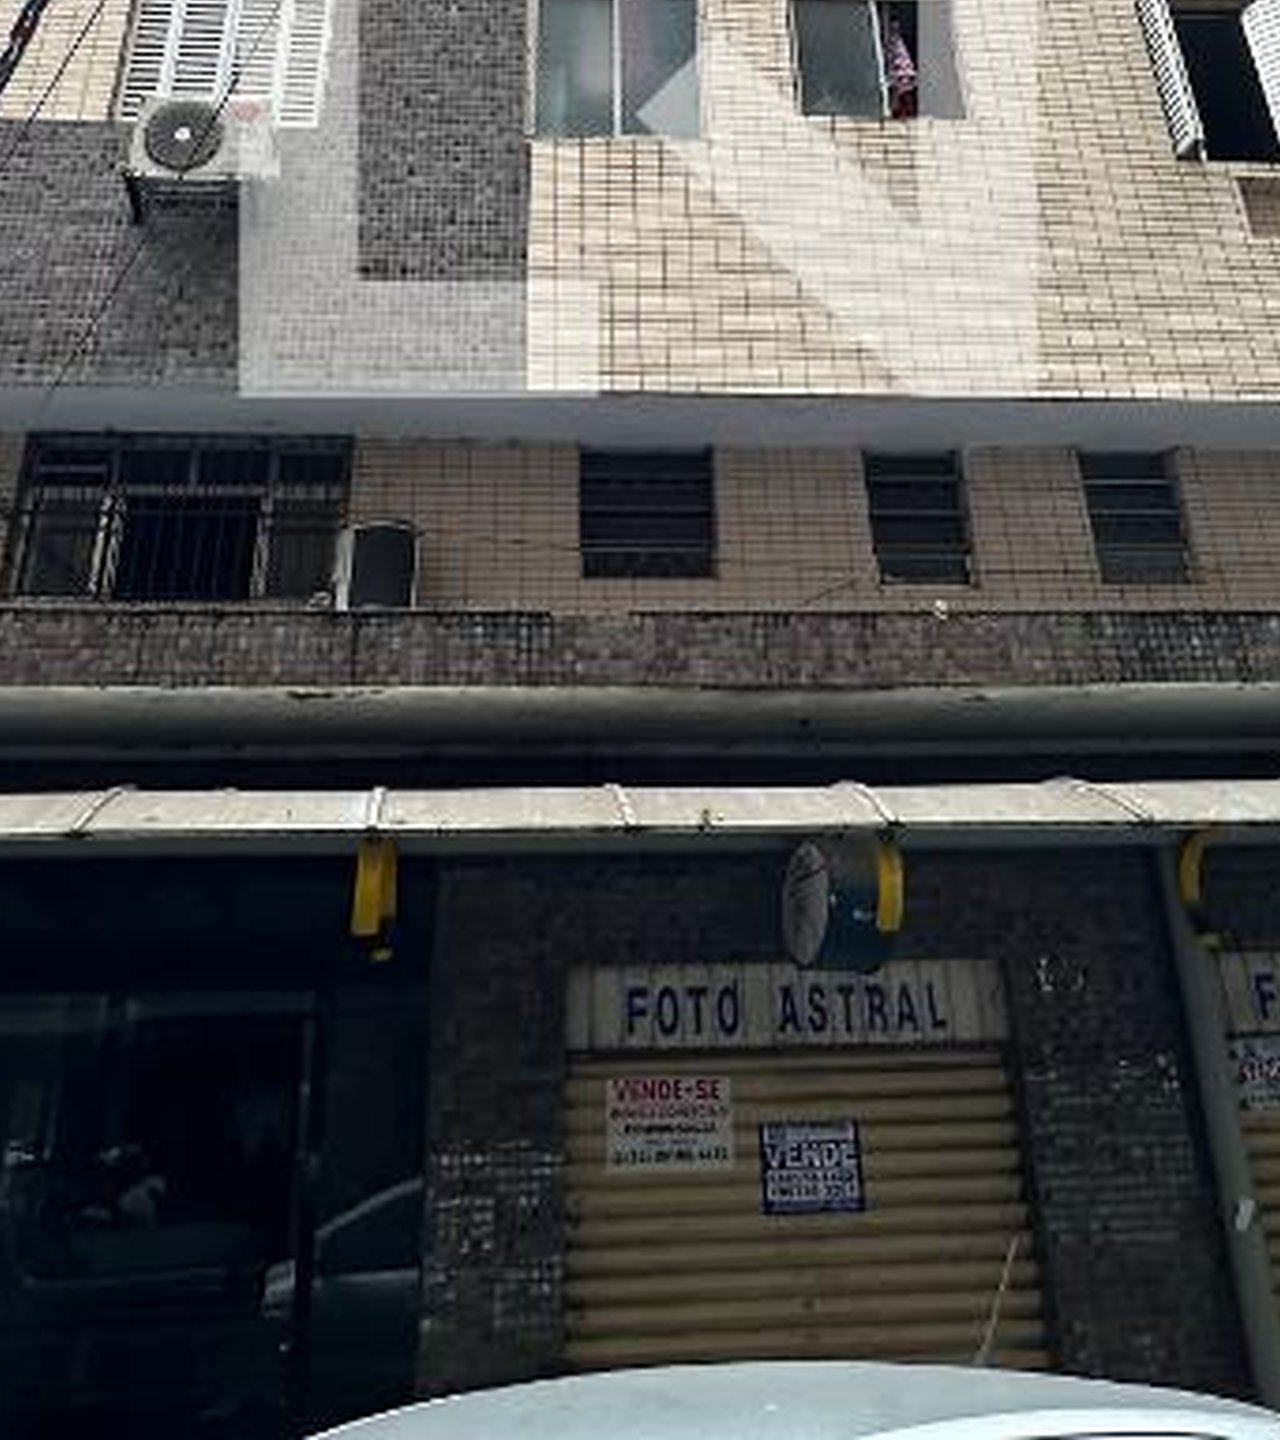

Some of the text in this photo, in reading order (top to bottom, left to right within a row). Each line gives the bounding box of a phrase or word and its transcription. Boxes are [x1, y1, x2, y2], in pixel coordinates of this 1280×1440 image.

[626, 982, 947, 1036] FOTO ASTRAL
[612, 1078, 720, 1101] VENDE-SE
[765, 1140, 859, 1169] VENDE
